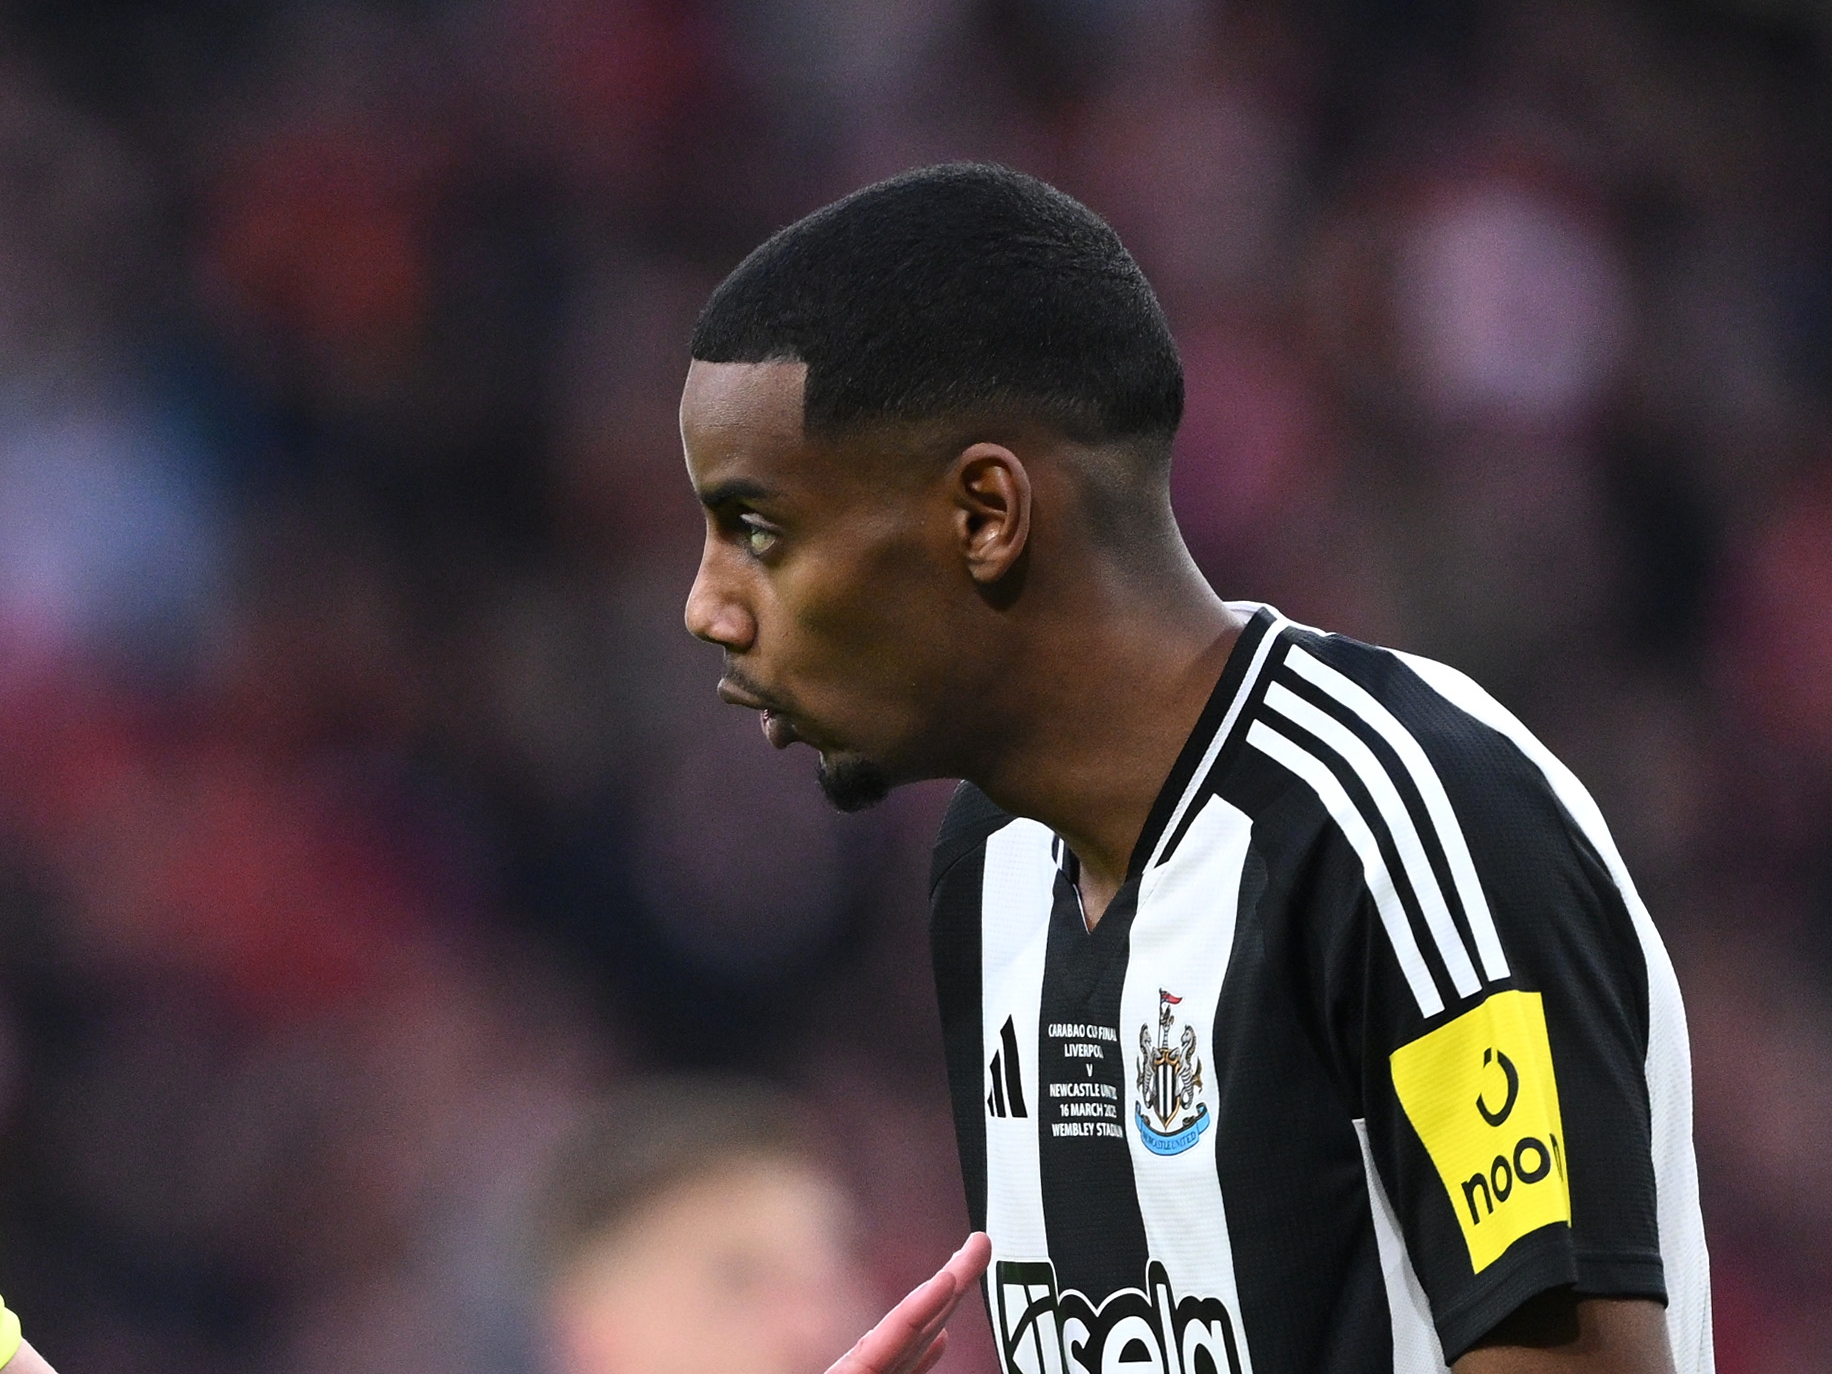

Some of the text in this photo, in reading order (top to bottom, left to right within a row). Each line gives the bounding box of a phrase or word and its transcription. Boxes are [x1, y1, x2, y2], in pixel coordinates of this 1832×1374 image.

[1048, 1023, 1085, 1038] CARABAO
[1085, 1063, 1093, 1077] V
[1049, 1083, 1100, 1097] NEWCASTLE
[1059, 1103, 1069, 1117] 16
[1070, 1102, 1103, 1117] MARCH
[1051, 1122, 1094, 1137] WEMBLEY
